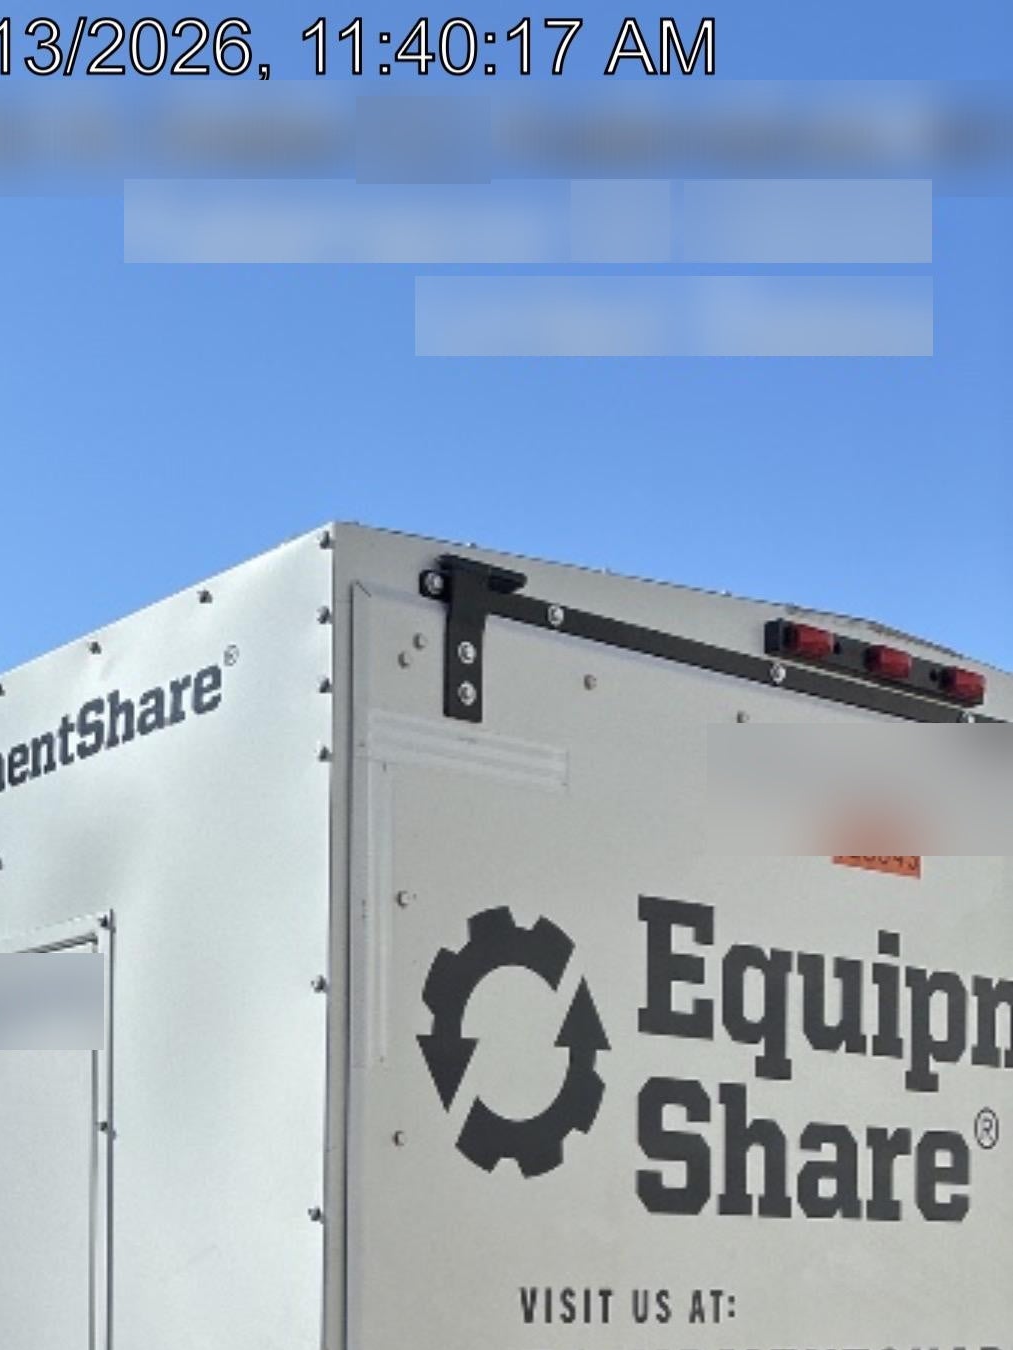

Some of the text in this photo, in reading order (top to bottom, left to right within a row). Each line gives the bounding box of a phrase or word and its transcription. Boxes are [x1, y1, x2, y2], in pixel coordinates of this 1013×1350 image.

[520, 1286, 736, 1325] VISIT US AT:
